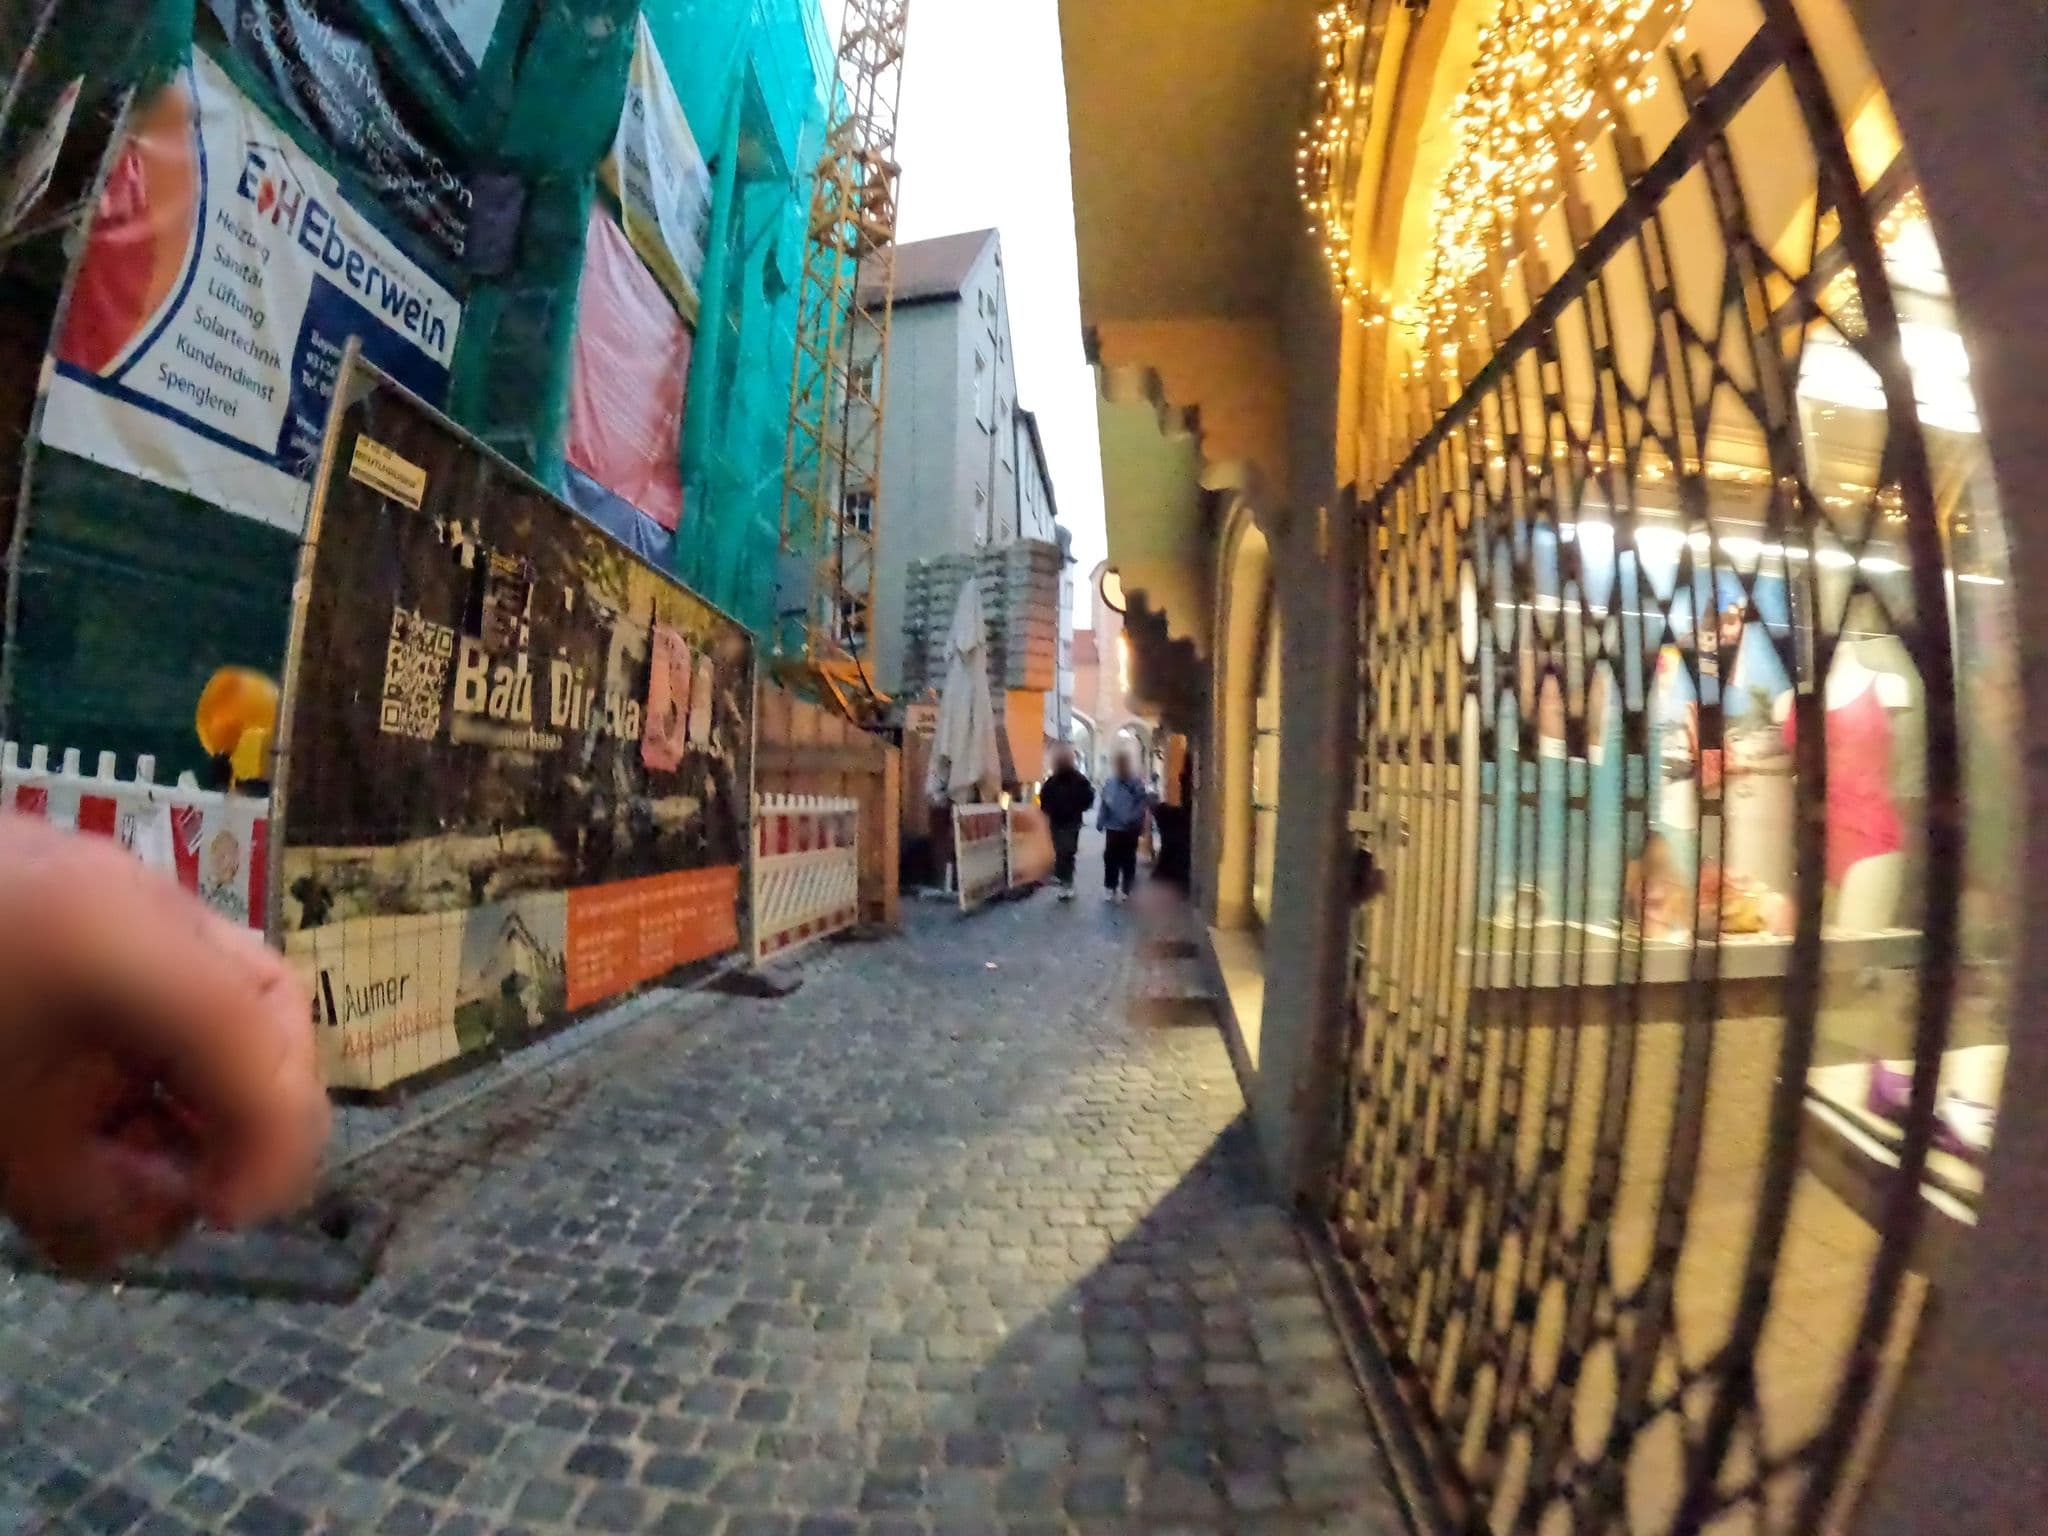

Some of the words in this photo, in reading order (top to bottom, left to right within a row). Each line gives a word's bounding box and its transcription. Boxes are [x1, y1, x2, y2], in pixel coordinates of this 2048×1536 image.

[216, 208, 270, 263] Heizug
[298, 196, 447, 353] Eberwein
[207, 276, 265, 329] Lüftung
[193, 305, 281, 369] Solartechnik
[158, 362, 238, 417] Spenglerei
[176, 333, 275, 402] Kundendienst
[344, 973, 410, 1022] Aumer
